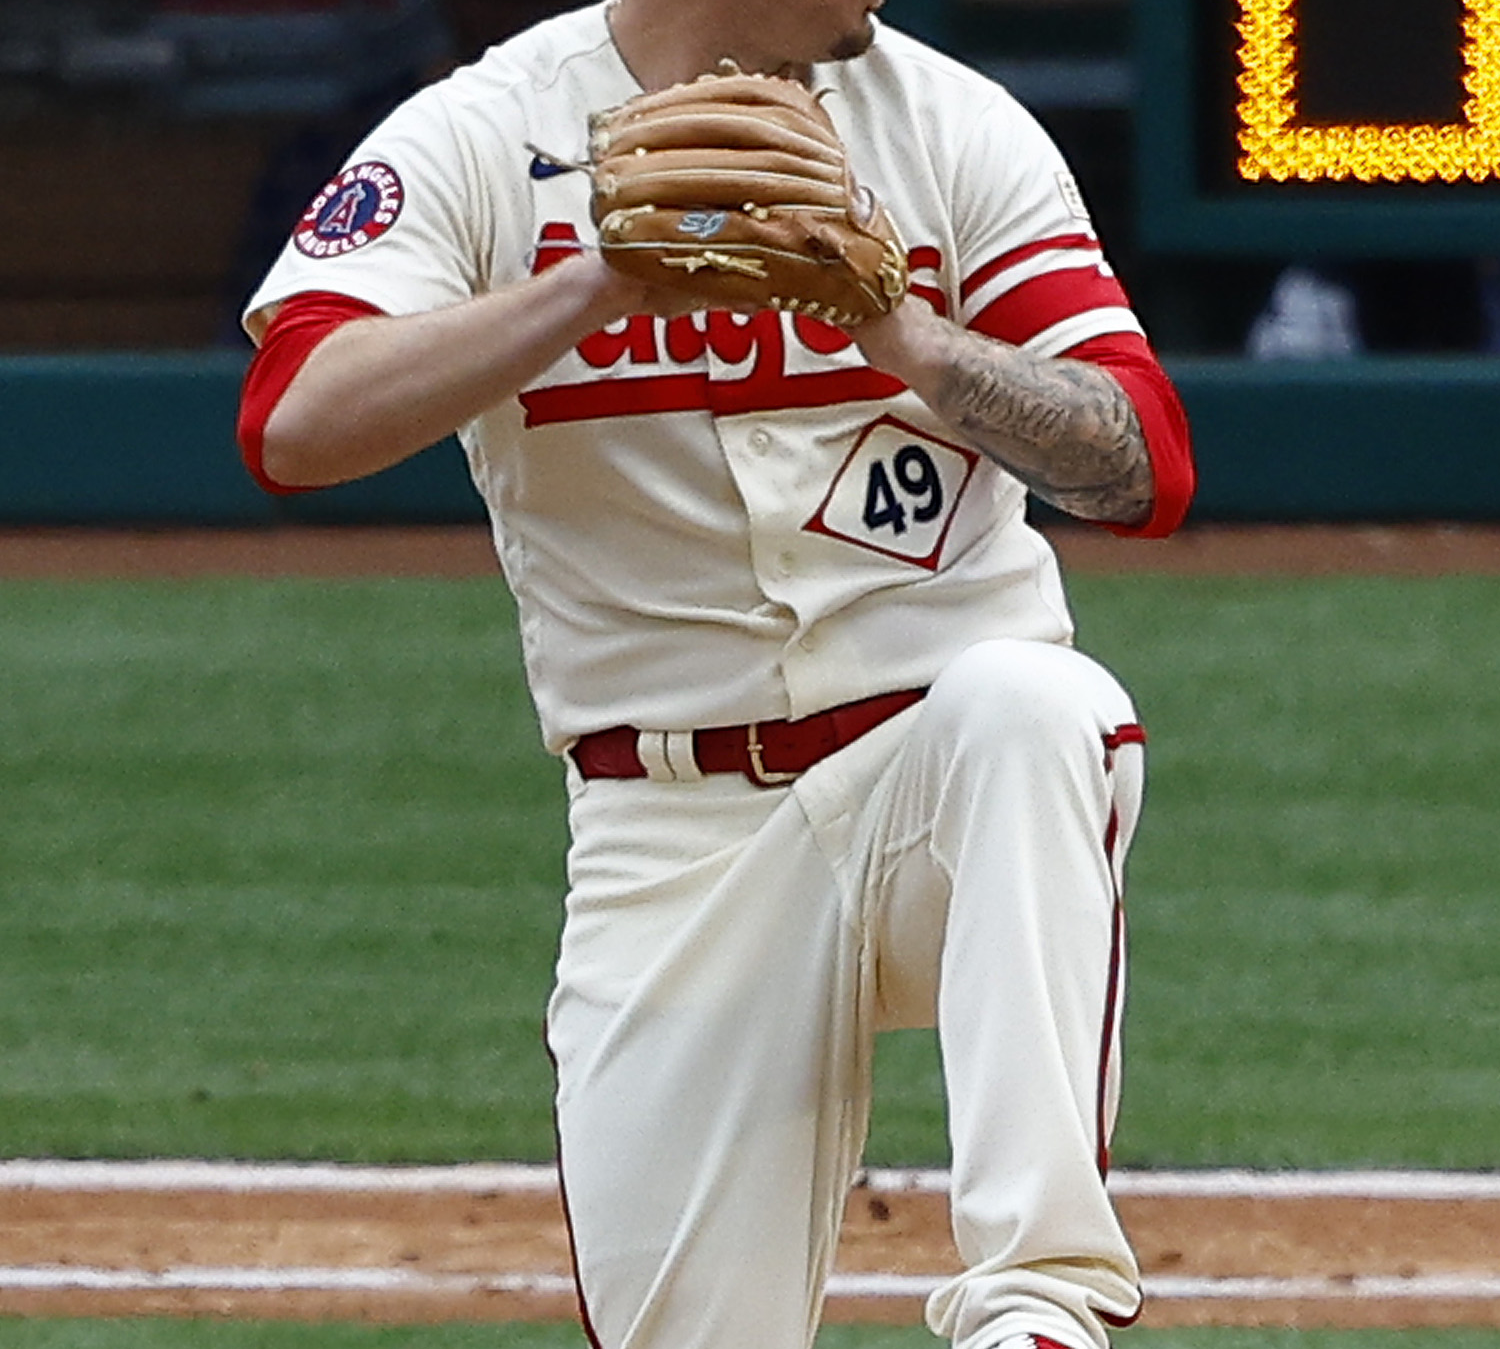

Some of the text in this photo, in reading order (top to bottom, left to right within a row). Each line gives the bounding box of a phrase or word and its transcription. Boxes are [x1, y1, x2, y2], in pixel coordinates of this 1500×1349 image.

[303, 165, 400, 225] LOS ANGELES
[862, 444, 943, 535] 49
